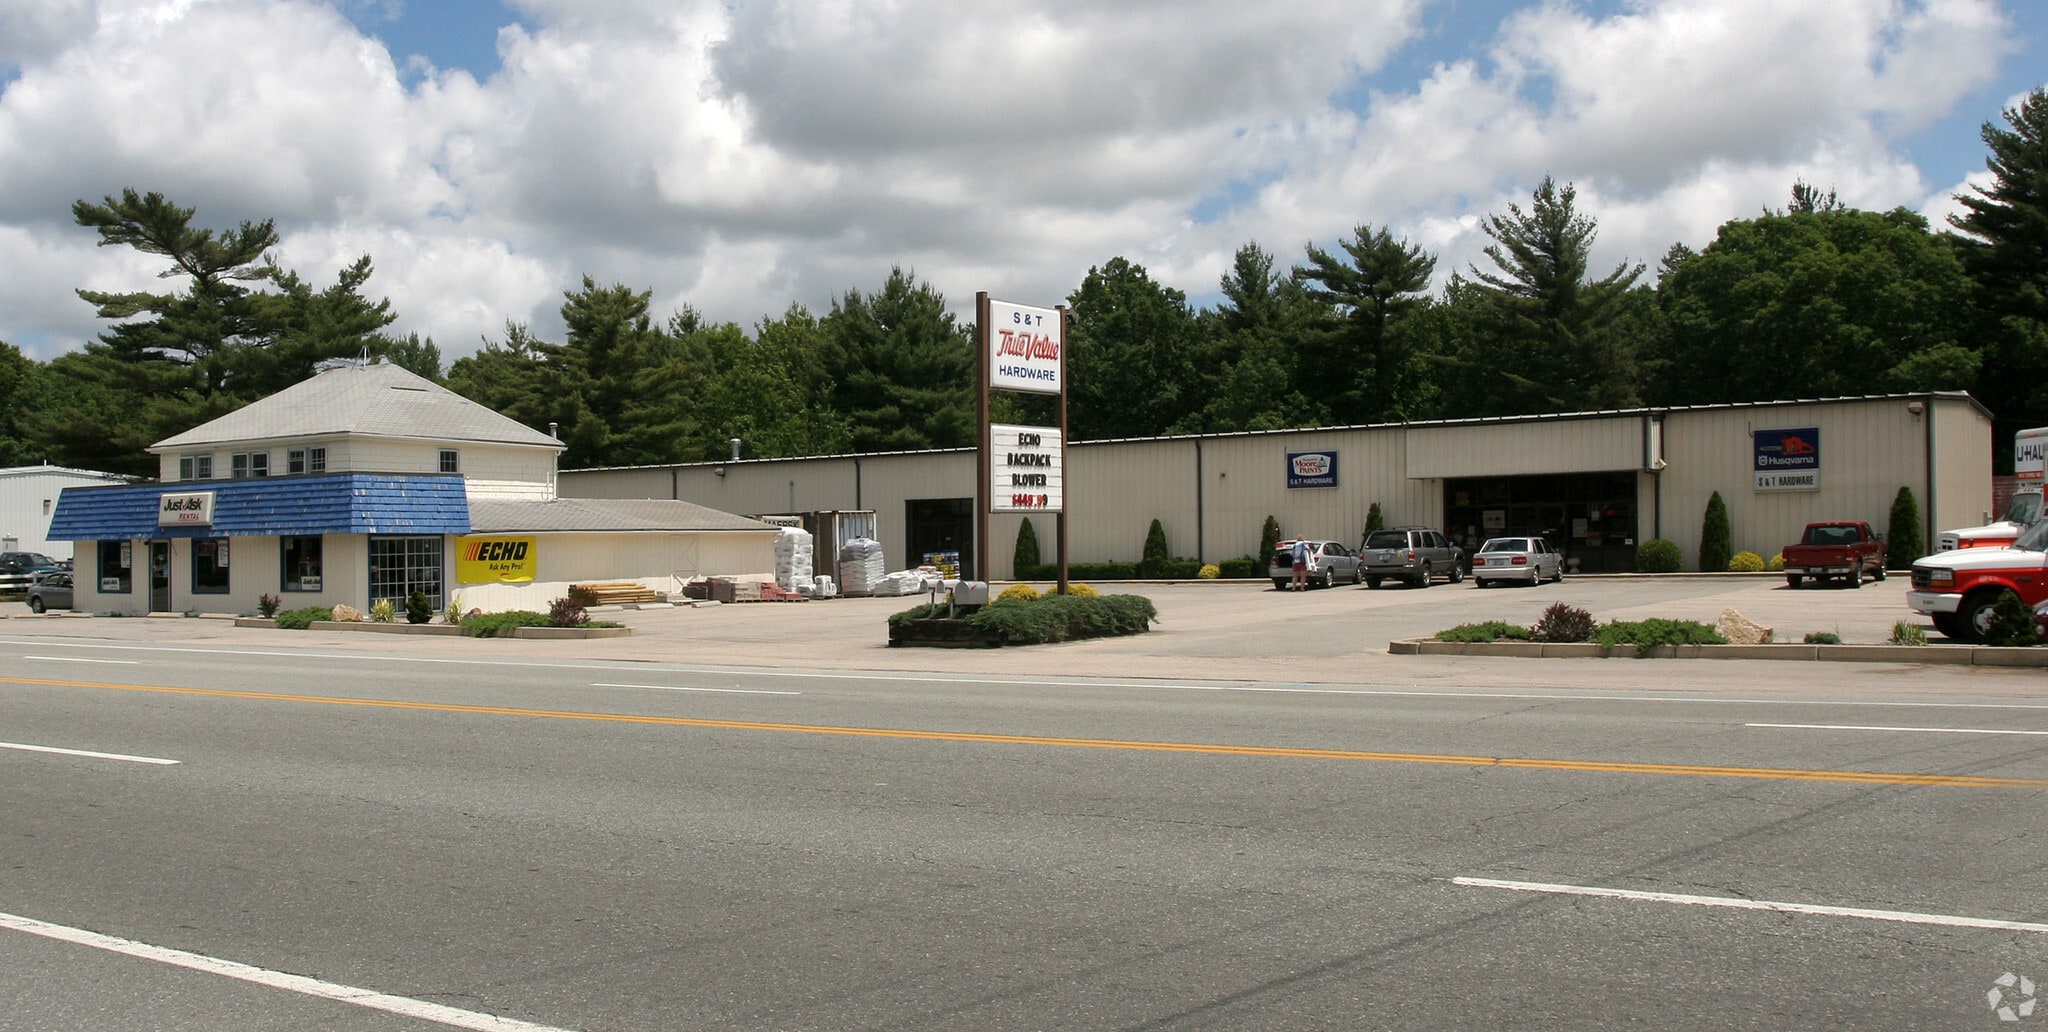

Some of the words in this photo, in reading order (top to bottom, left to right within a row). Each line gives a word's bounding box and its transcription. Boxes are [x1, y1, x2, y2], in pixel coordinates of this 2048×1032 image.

[1013, 312, 1020, 324] S
[1024, 314, 1031, 325] &
[1036, 315, 1042, 327] T
[999, 365, 1055, 381] HARDWARE
[1018, 433, 1041, 446] ECHO
[1007, 453, 1051, 466] BACKPACK
[1769, 456, 1814, 465] Husqvarna
[1012, 473, 1046, 487] BLOWER
[1758, 477, 1763, 486] S
[1765, 478, 1769, 486] &
[1772, 477, 1776, 486] T
[1779, 475, 1814, 486] HARDWARE
[164, 499, 183, 511] Just
[184, 498, 202, 510] Ask
[478, 542, 528, 561] ECHO
[489, 563, 499, 571] Ask
[500, 563, 510, 572] Any
